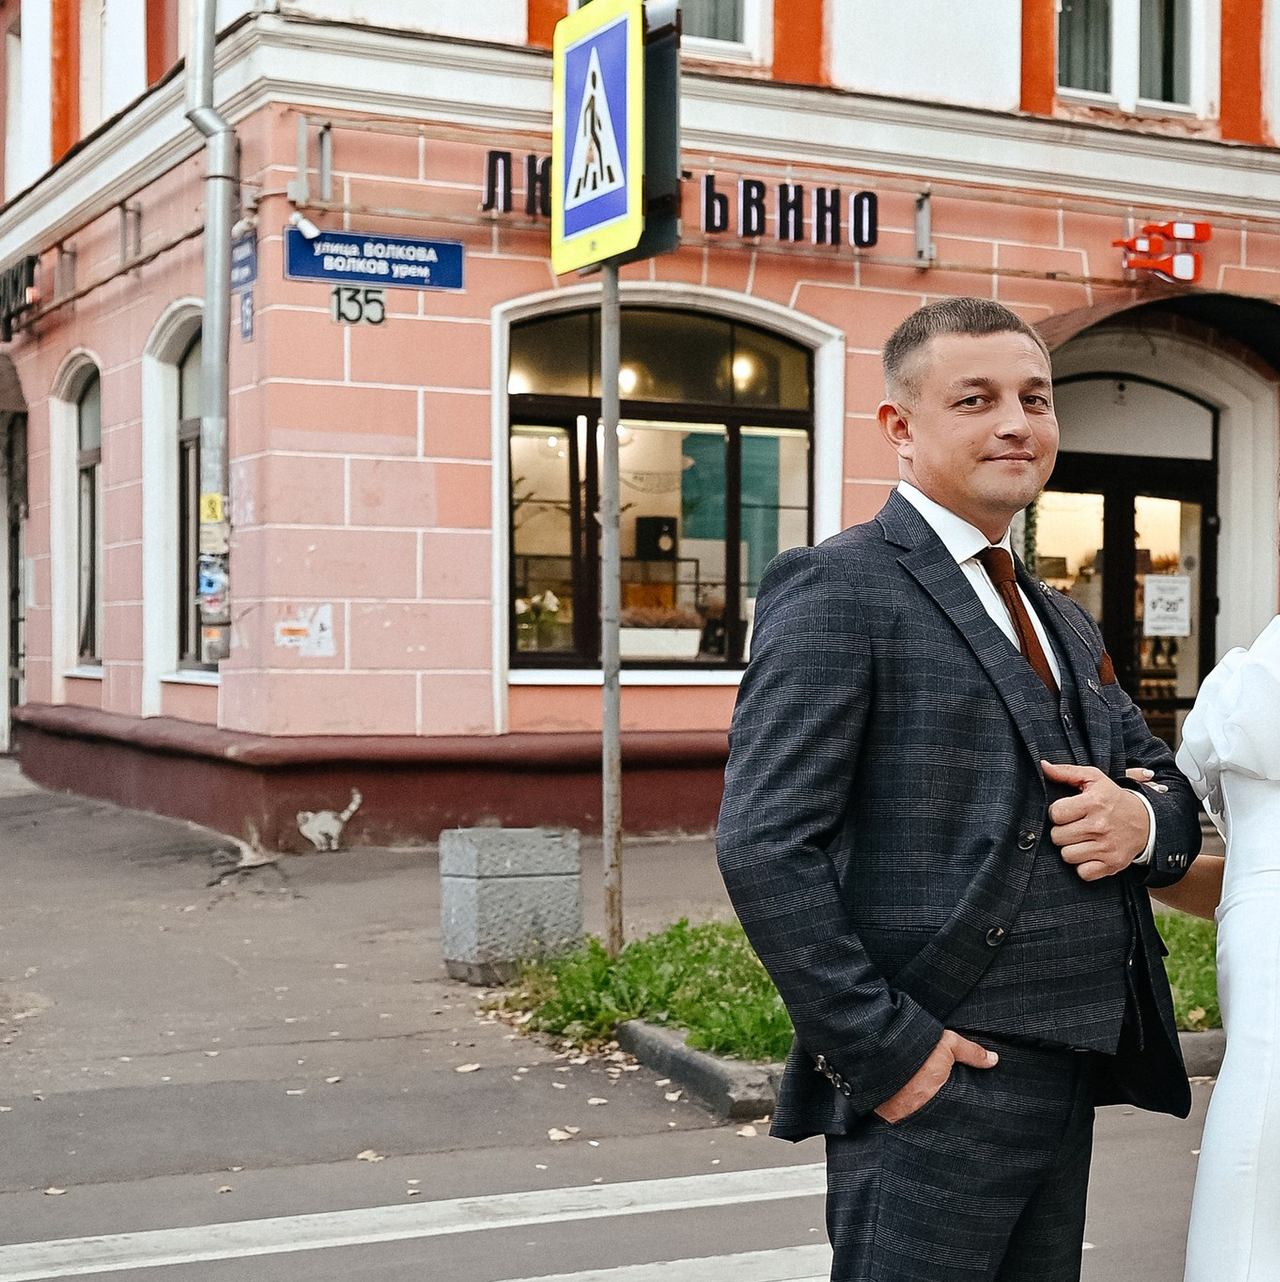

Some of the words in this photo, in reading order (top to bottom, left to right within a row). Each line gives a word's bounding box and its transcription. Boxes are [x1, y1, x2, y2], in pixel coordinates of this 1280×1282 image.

[481, 150, 878, 248] ЛЮЬВИНО
[323, 255, 389, 275] ВОЛКОВ
[363, 242, 438, 263] ВОЛКОВА
[331, 287, 385, 325] 135
